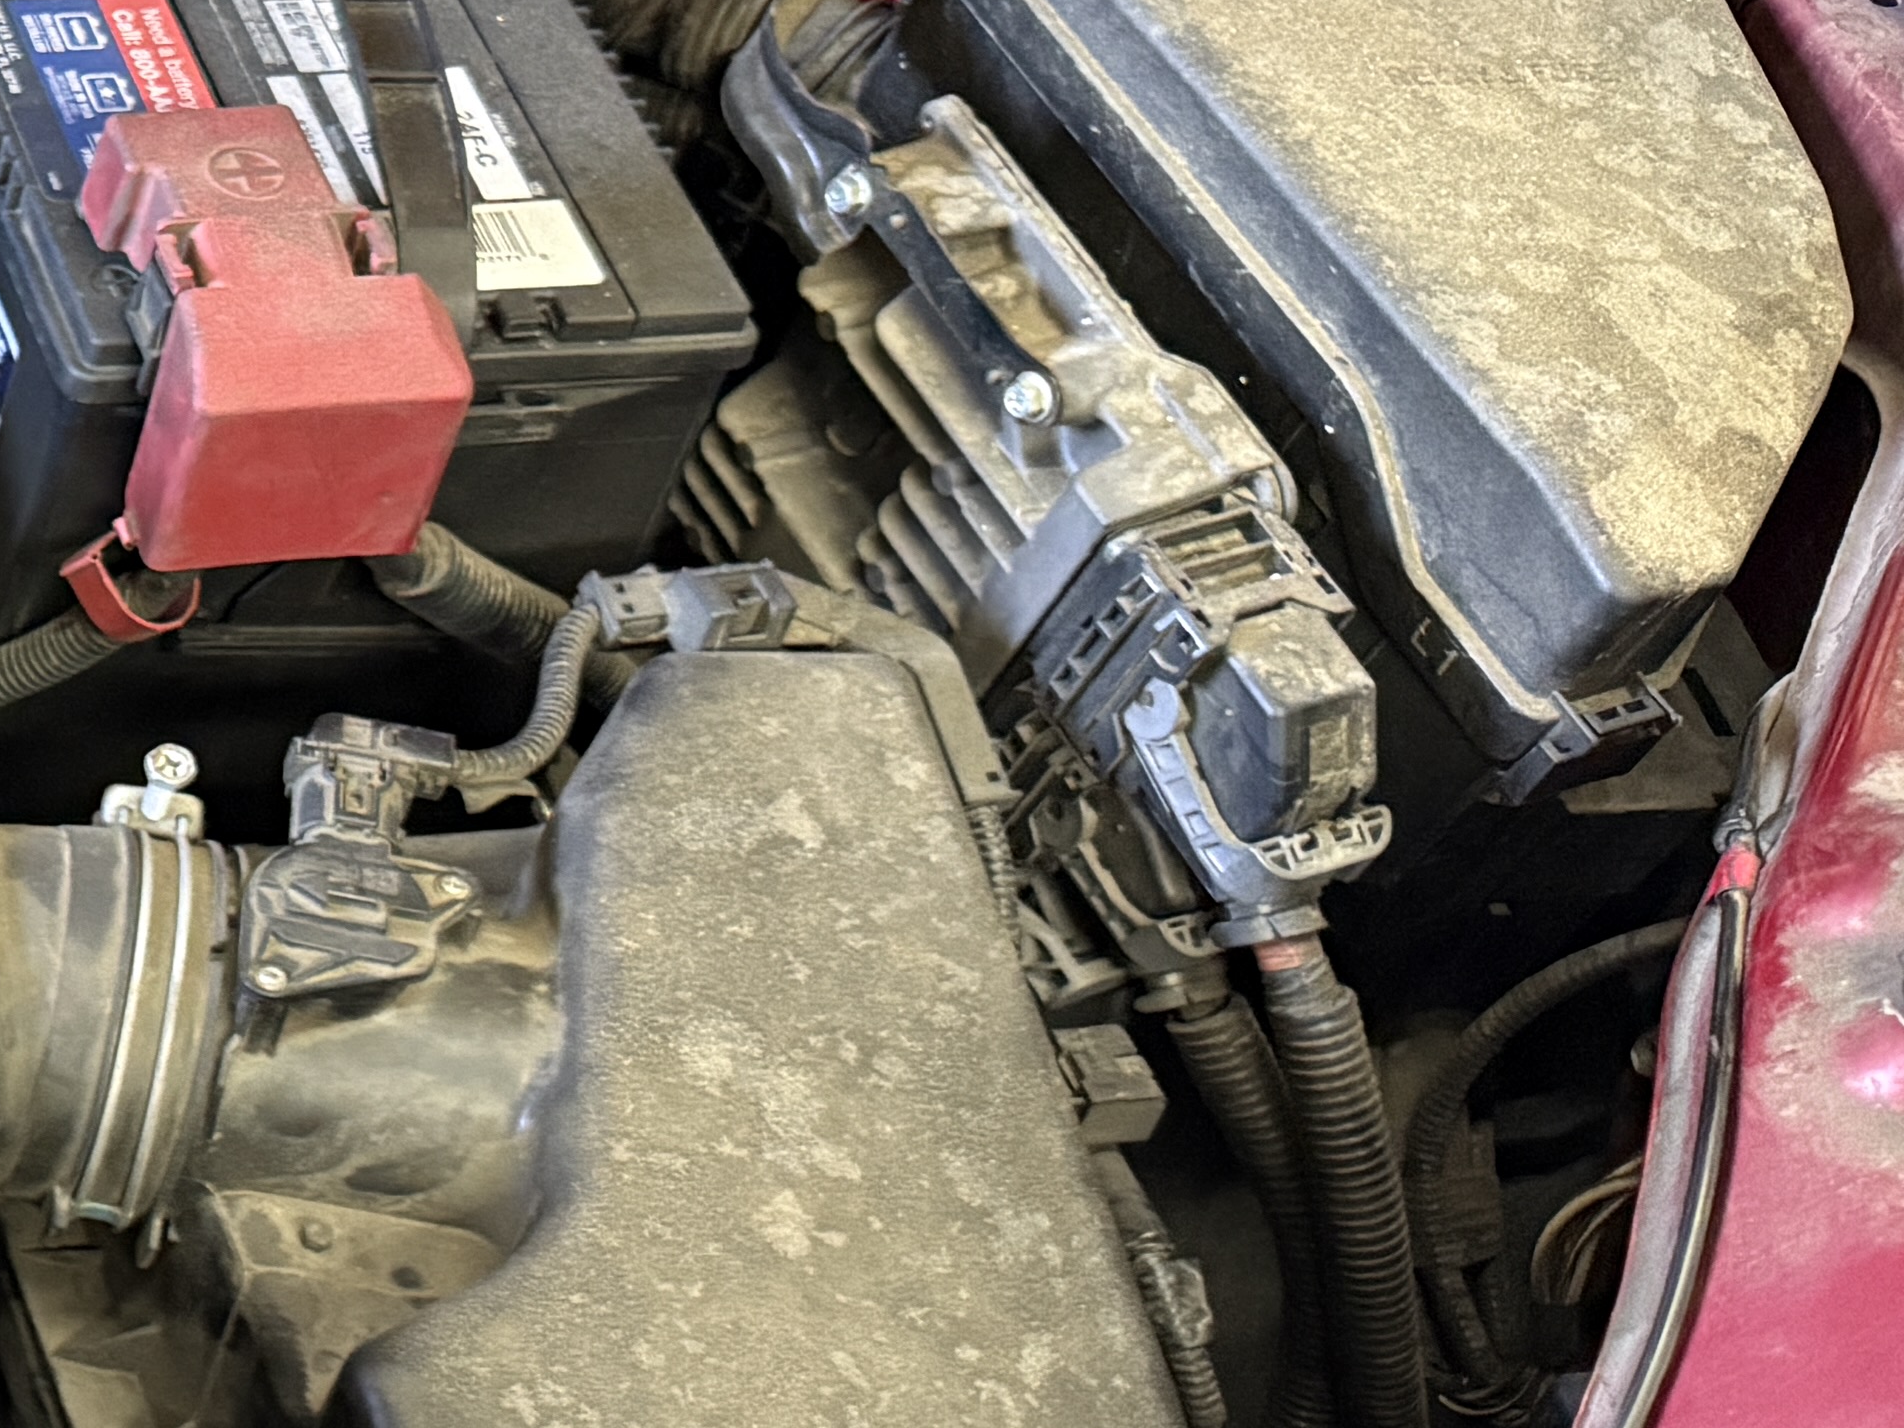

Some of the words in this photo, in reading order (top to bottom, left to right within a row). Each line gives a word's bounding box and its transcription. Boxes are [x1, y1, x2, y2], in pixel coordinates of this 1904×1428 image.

[111, 9, 143, 45] Call:
[139, 8, 172, 45] Need
[157, 46, 174, 58] a
[163, 59, 200, 109] battery
